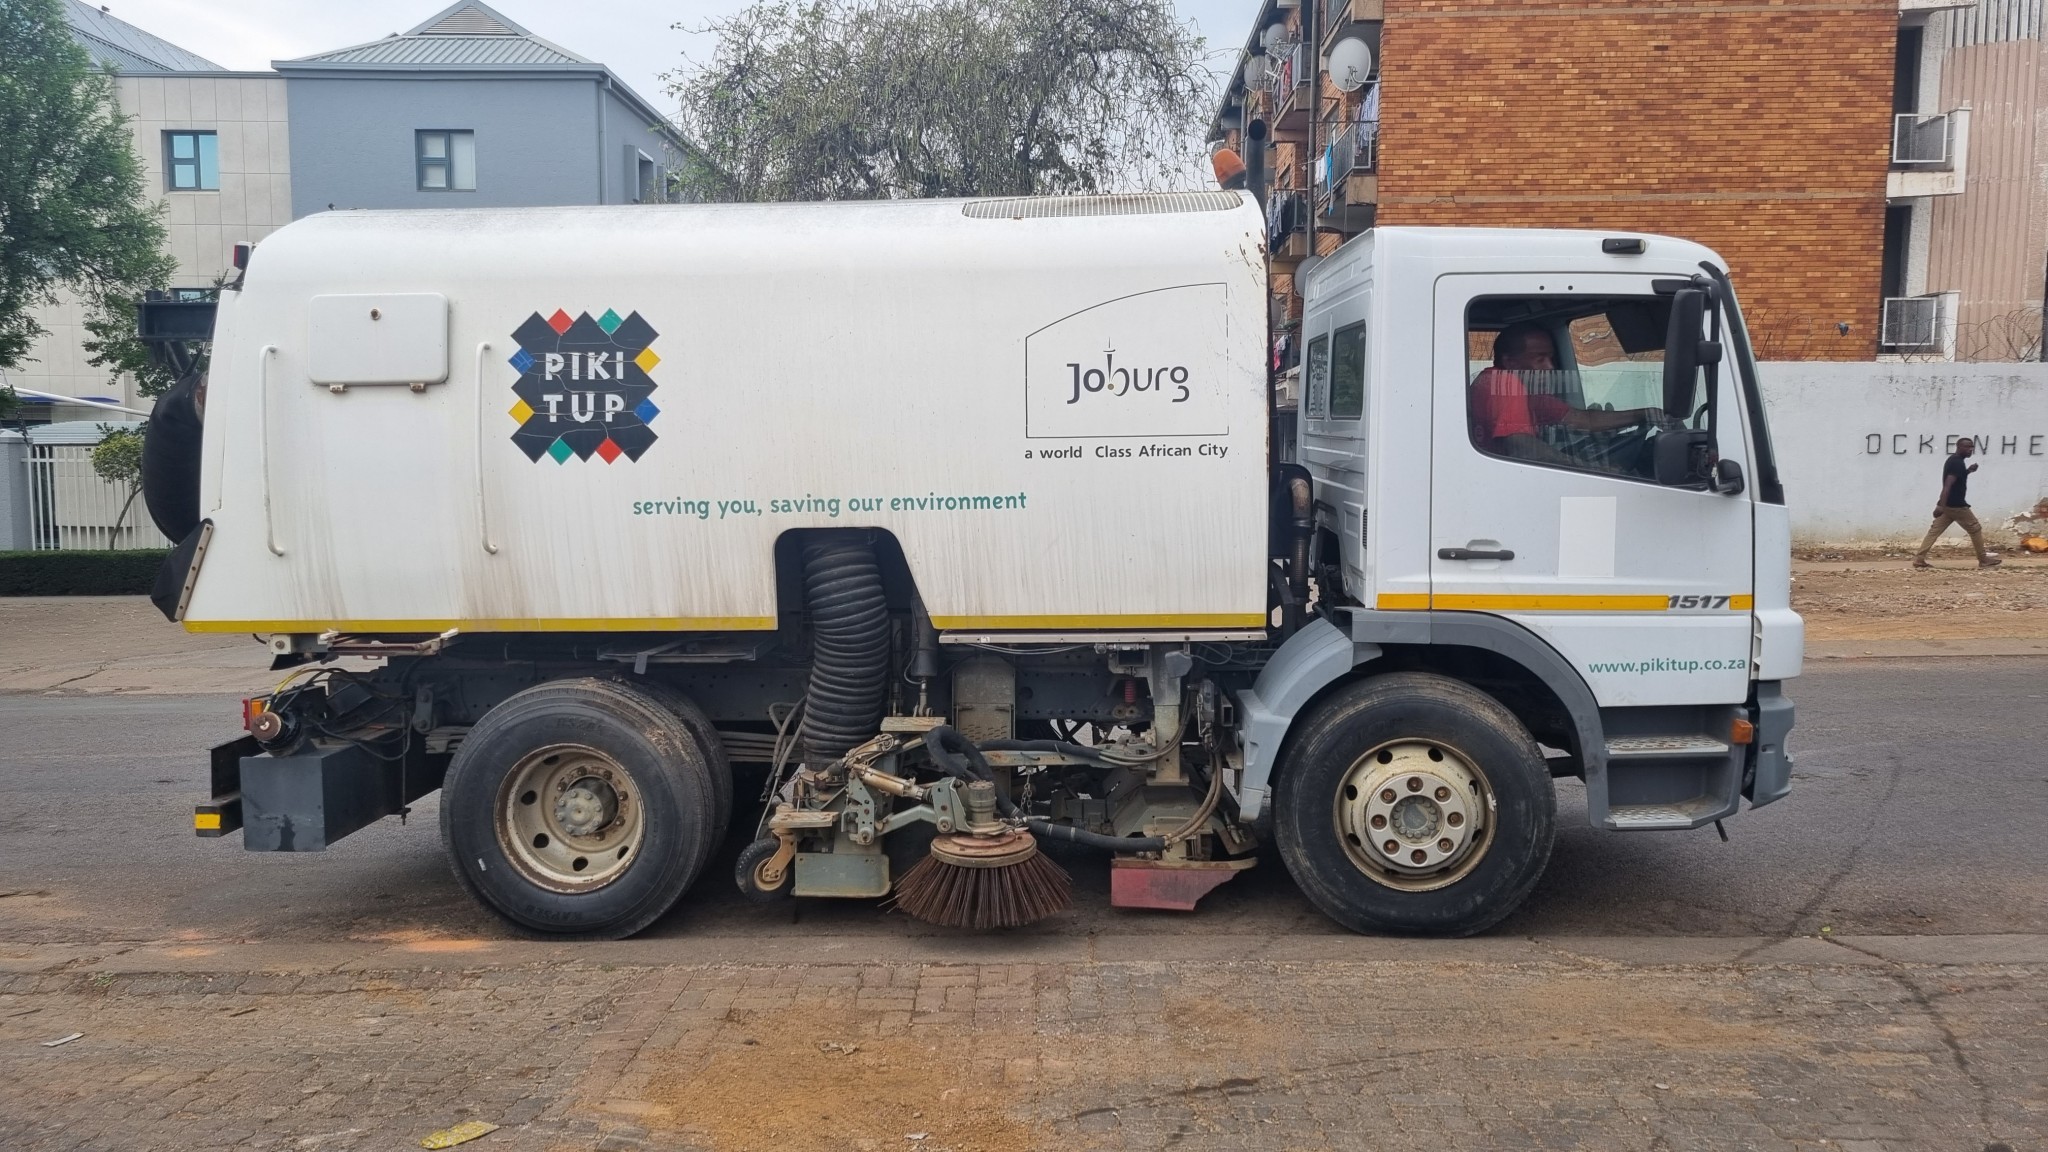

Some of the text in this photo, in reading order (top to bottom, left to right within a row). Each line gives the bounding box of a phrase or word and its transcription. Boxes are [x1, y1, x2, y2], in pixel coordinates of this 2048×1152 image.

[545, 352, 624, 380] PIKI
[1066, 345, 1190, 404] Joburg
[543, 392, 625, 423] TUP
[1024, 444, 1228, 459] a world Class African City
[633, 492, 1027, 519] serving you, saving our environment
[1668, 595, 1730, 609] 1517
[1589, 658, 1746, 674] www.pikitup.co.za
